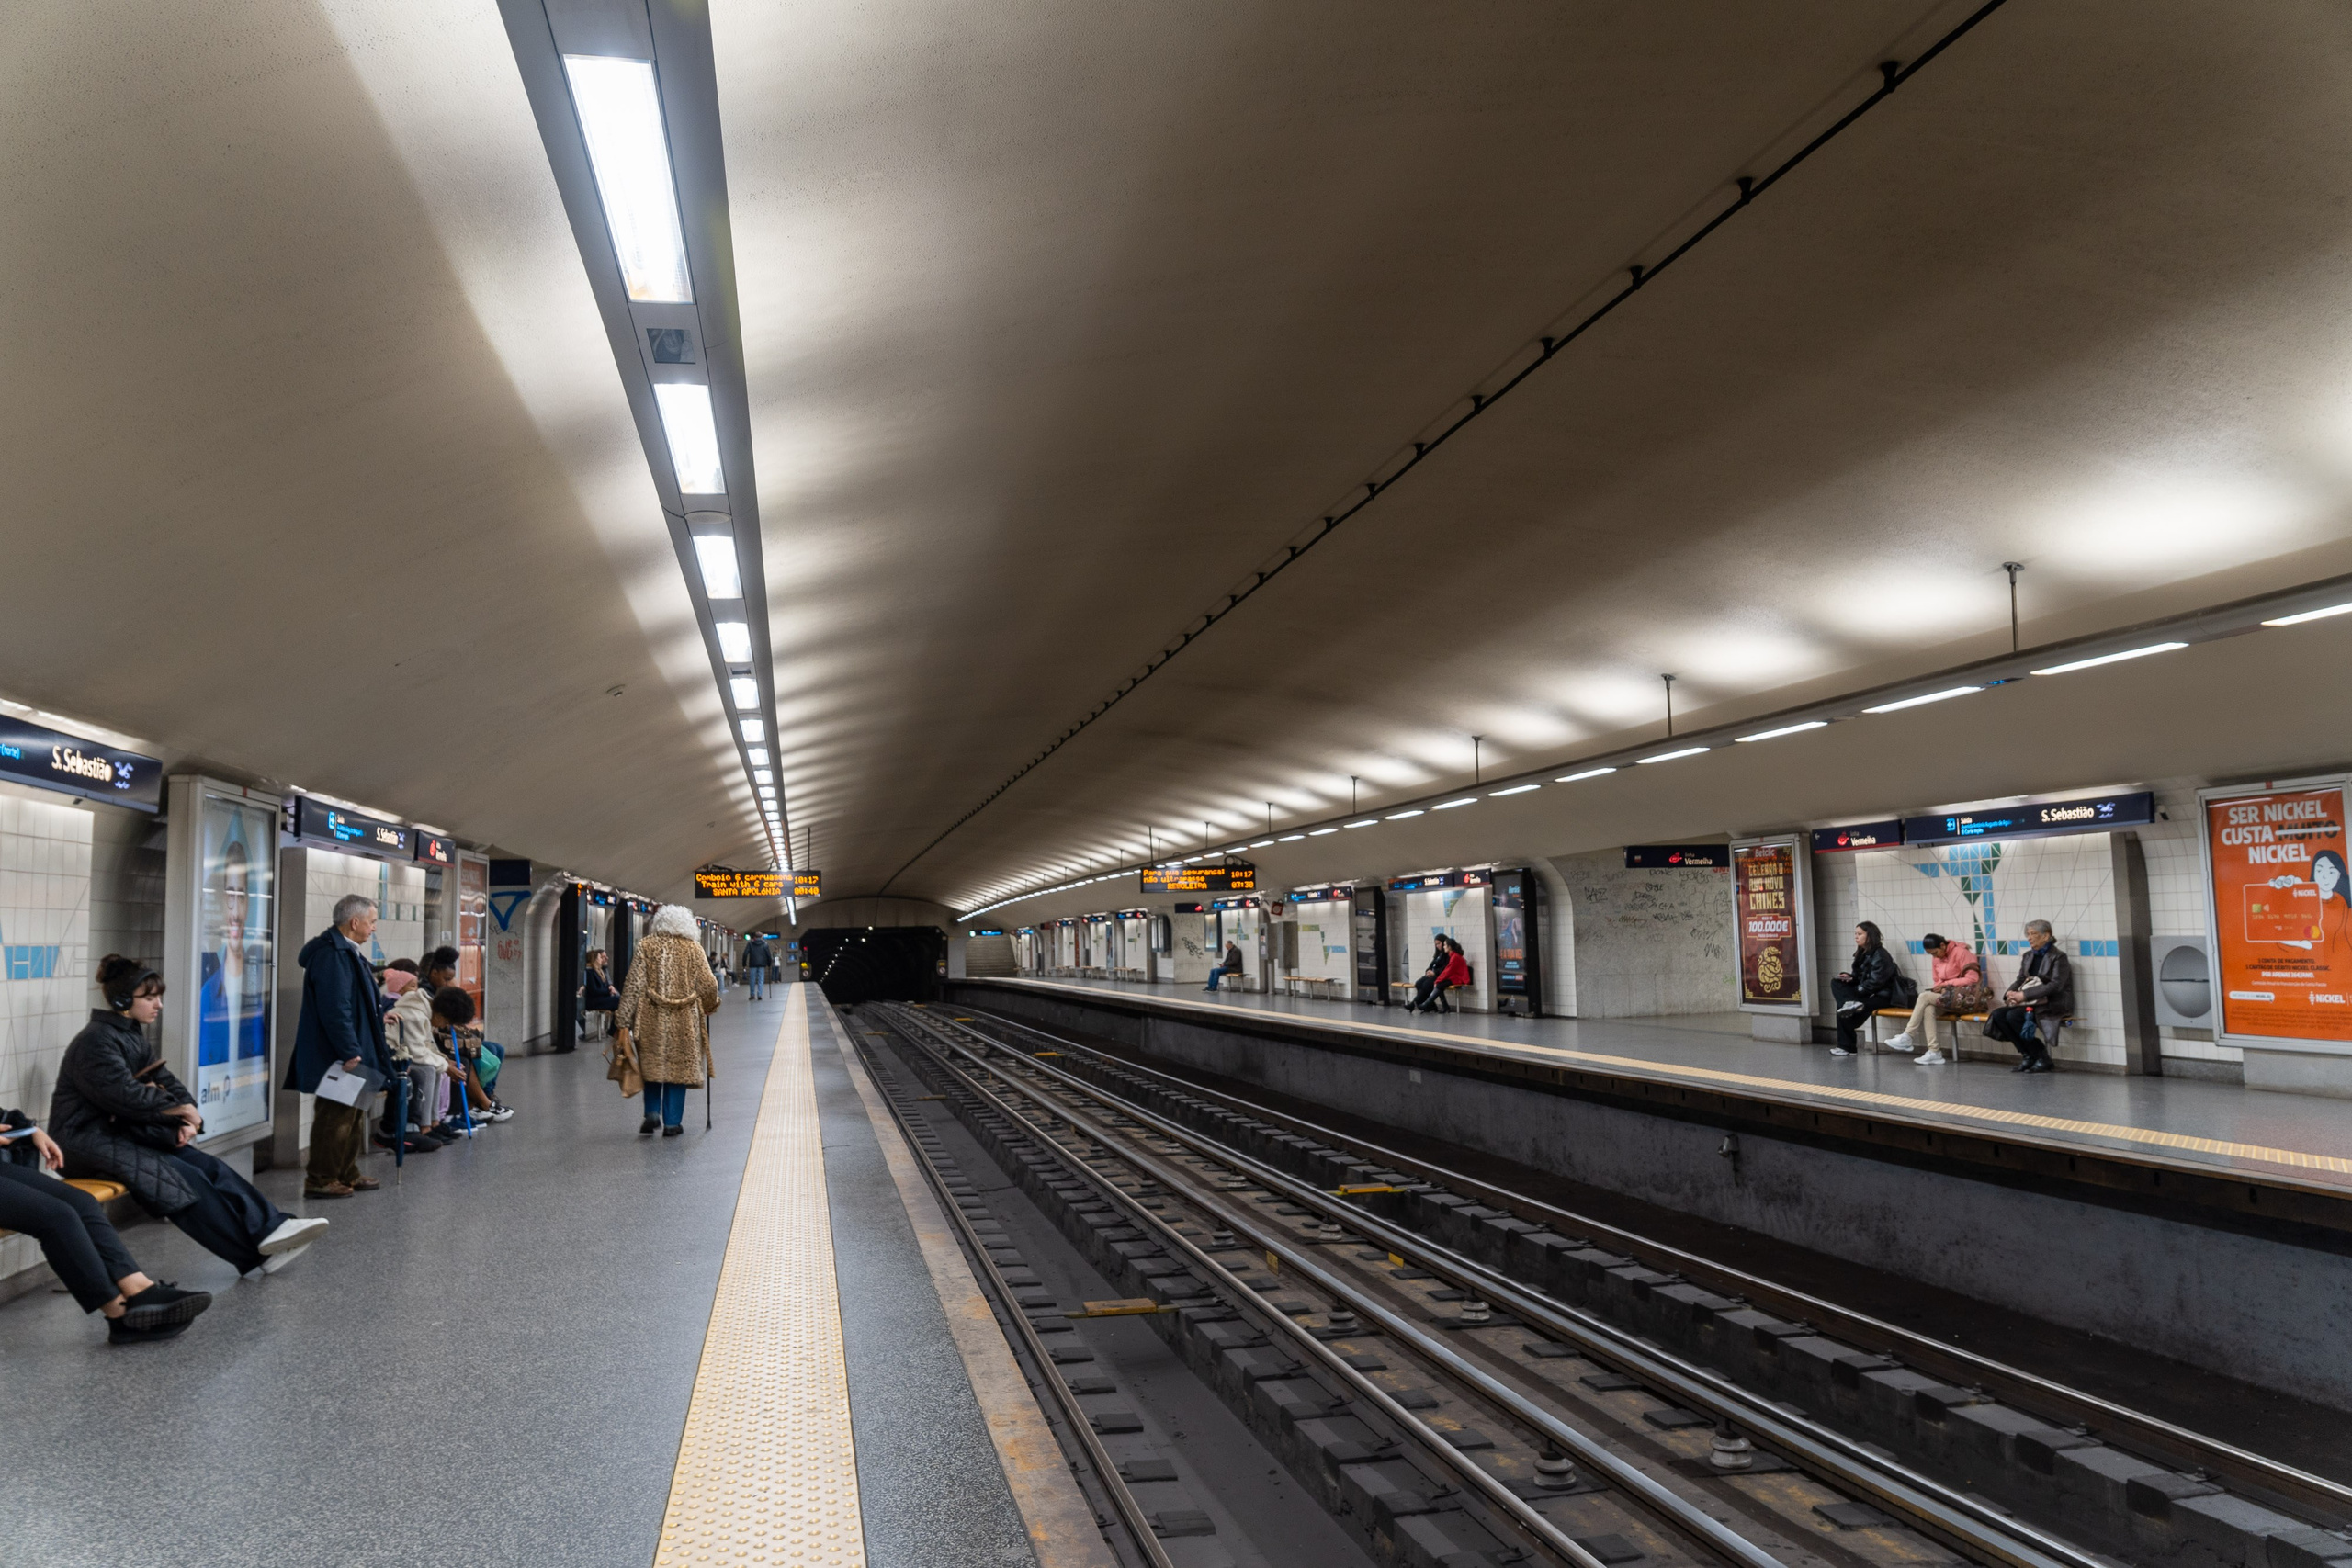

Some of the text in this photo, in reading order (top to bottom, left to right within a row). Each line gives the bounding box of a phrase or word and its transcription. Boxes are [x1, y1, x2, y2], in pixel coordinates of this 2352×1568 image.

[1, 744, 20, 760] (norte)
[51, 745, 112, 782] S. Sebastião
[2041, 806, 2094, 822] S. Sebastião
[2228, 799, 2328, 825] SER NICKEL
[2221, 819, 2339, 845] CUSTA MUITO
[1850, 835, 1876, 846] Vermelha
[1755, 848, 1775, 857] Betclic
[2248, 843, 2311, 864] NICKEL
[1684, 857, 1713, 865] Vermelha
[1143, 869, 1162, 877] Para
[1231, 871, 1253, 879] 10:17
[1748, 863, 1777, 877] CELEBRA
[695, 873, 731, 882] Comboio
[734, 873, 741, 882] 6
[794, 875, 819, 885] 10:17
[1143, 875, 1159, 884] não
[1765, 876, 1783, 889] NOVO
[701, 880, 727, 888] Train
[729, 880, 751, 888] with
[753, 880, 760, 888] 6
[712, 887, 739, 896] SANTA
[794, 886, 820, 896] 00:40
[1748, 920, 1788, 932] 100.000€
